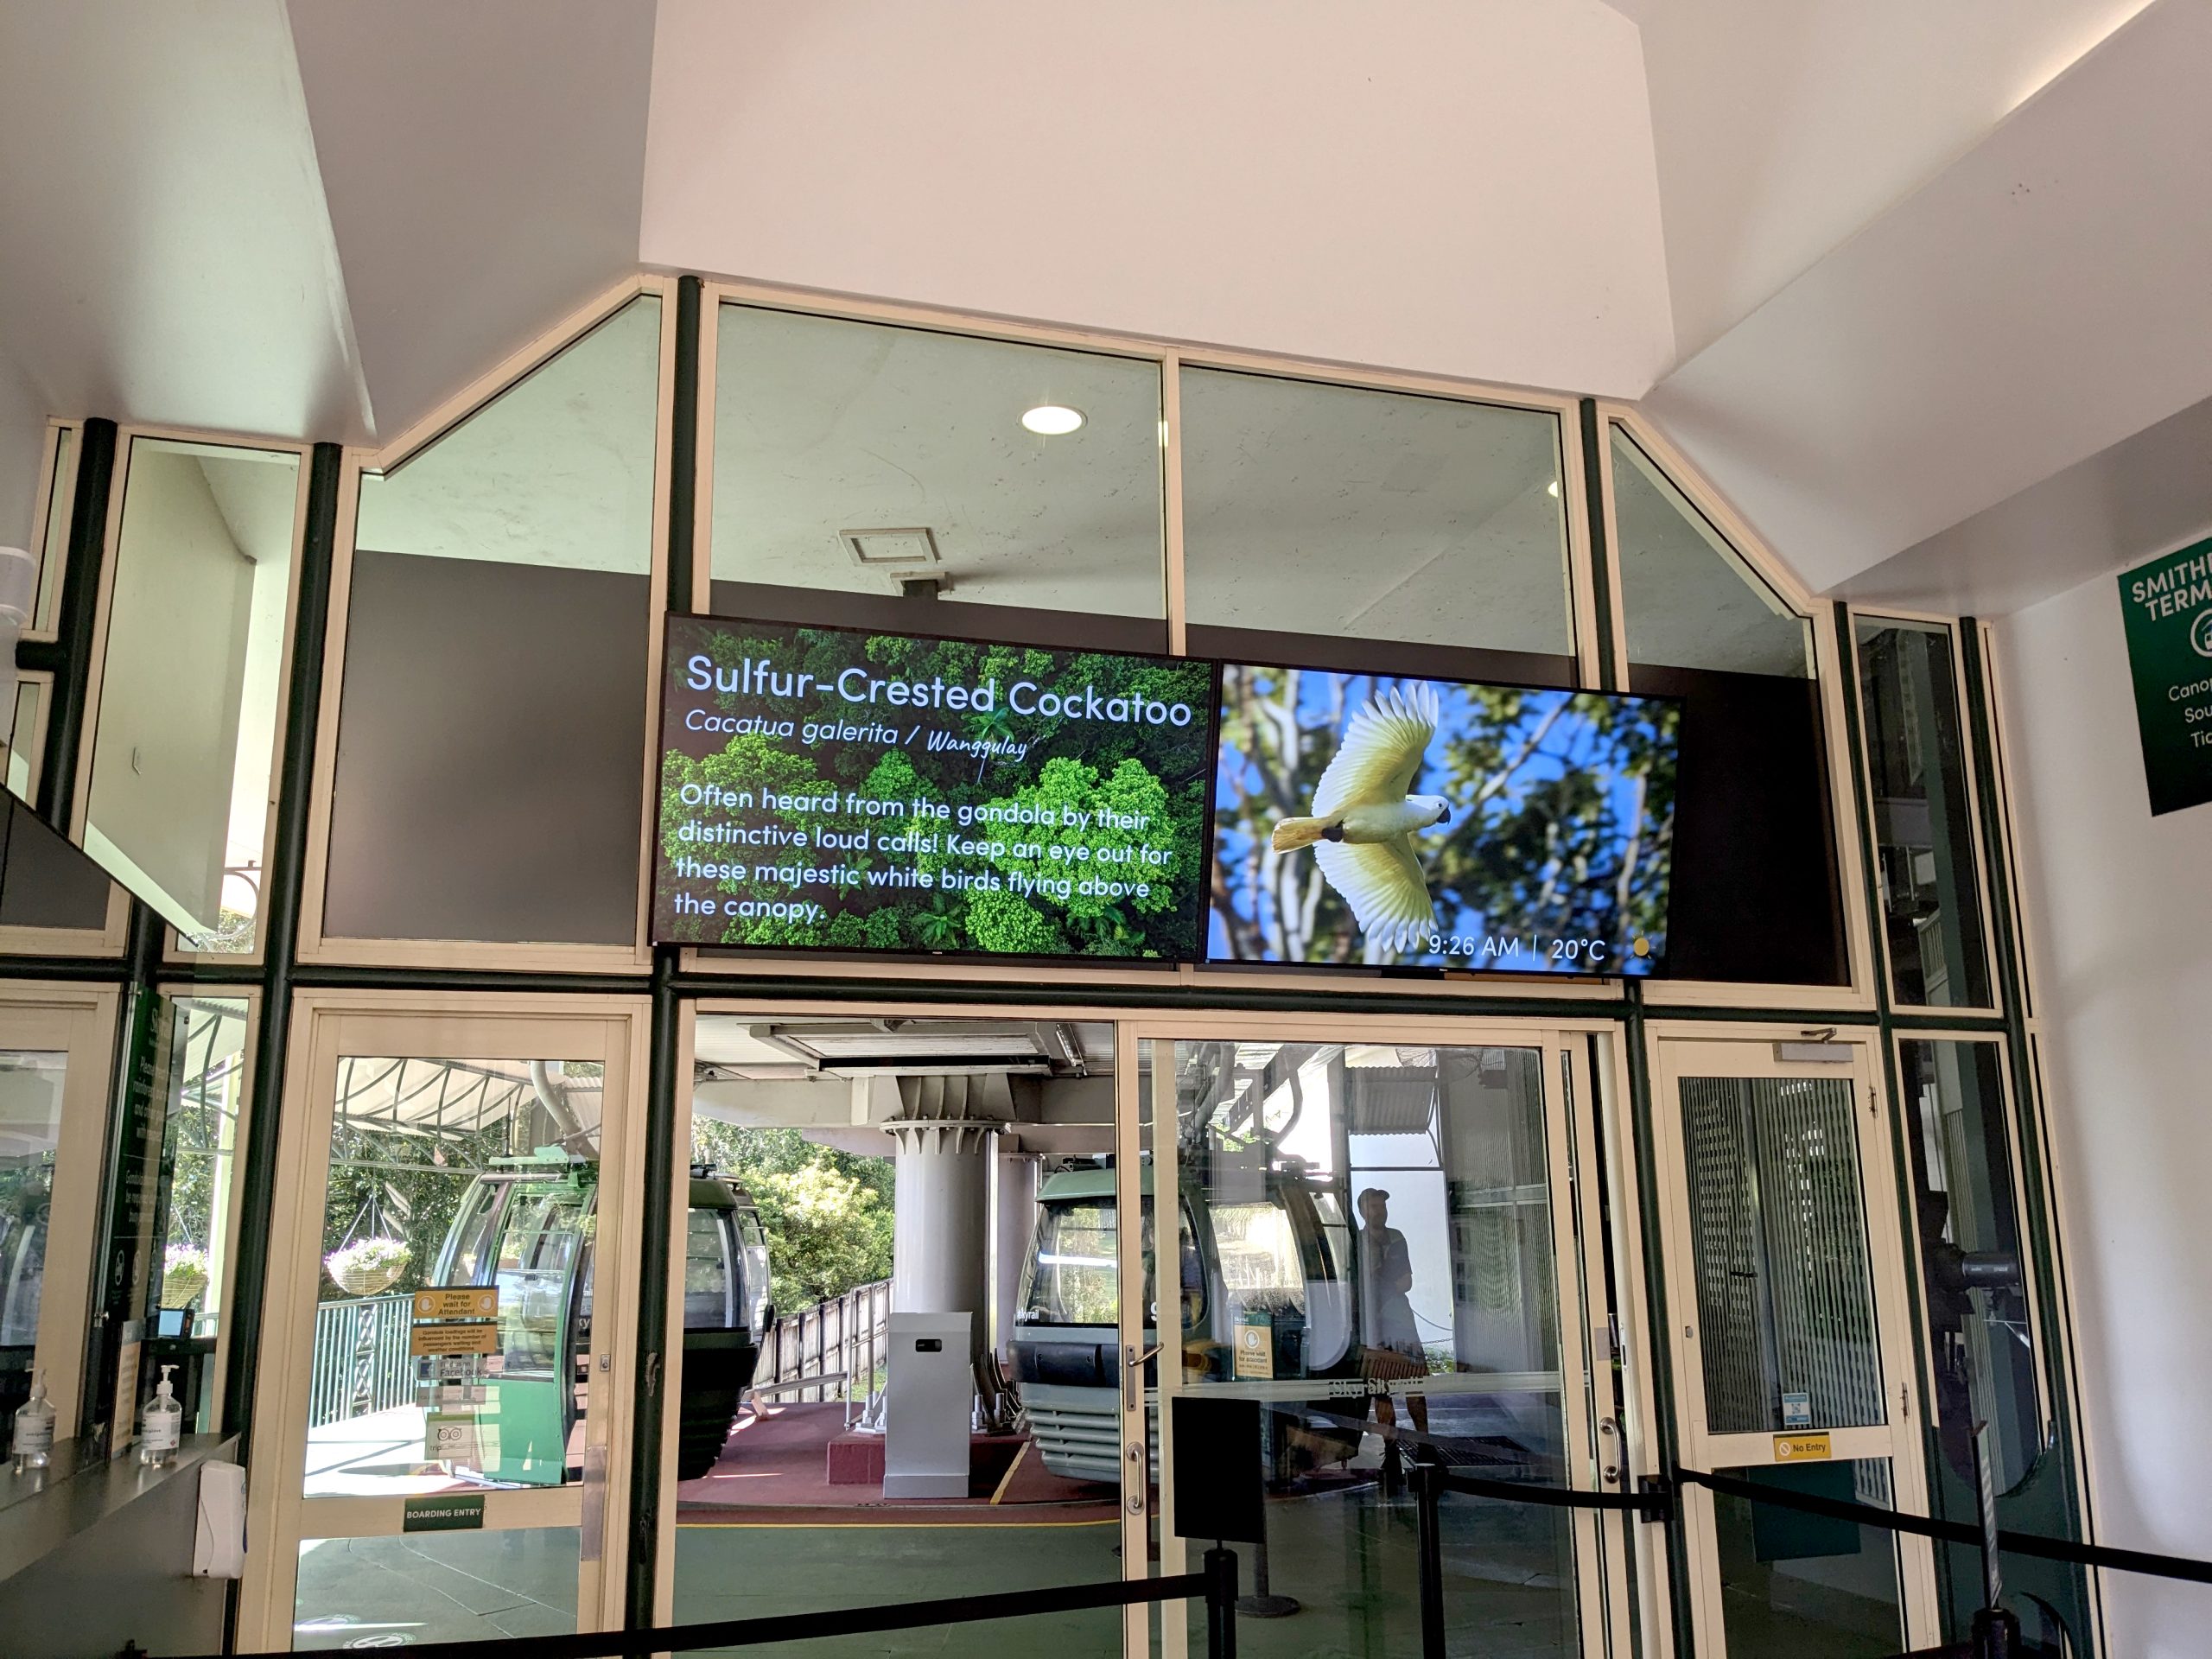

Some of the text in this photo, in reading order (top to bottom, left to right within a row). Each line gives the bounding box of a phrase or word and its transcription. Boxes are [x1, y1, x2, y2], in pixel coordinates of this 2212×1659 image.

[2132, 553, 2212, 603] SMITH
[687, 655, 1192, 727] Sulfur-Crested Cockatoo
[2168, 678, 2212, 702] Cano
[685, 709, 794, 737] Cacatua
[802, 719, 899, 745] galerita
[926, 729, 1027, 763] Wanggulay
[680, 784, 1150, 832] Often heard from the gondola by their
[677, 819, 1173, 865] distinctive loud calls! Keep an eye out for
[676, 856, 1150, 899] these majestic white birds flying above
[674, 893, 826, 924] the canopy.
[1428, 934, 1475, 956] 9:26
[1481, 936, 1519, 957] AM
[1551, 938, 1605, 961] 20°C
[1793, 1442, 1826, 1452] No Entry
[406, 1508, 481, 1519] BOARDING ENTRY
